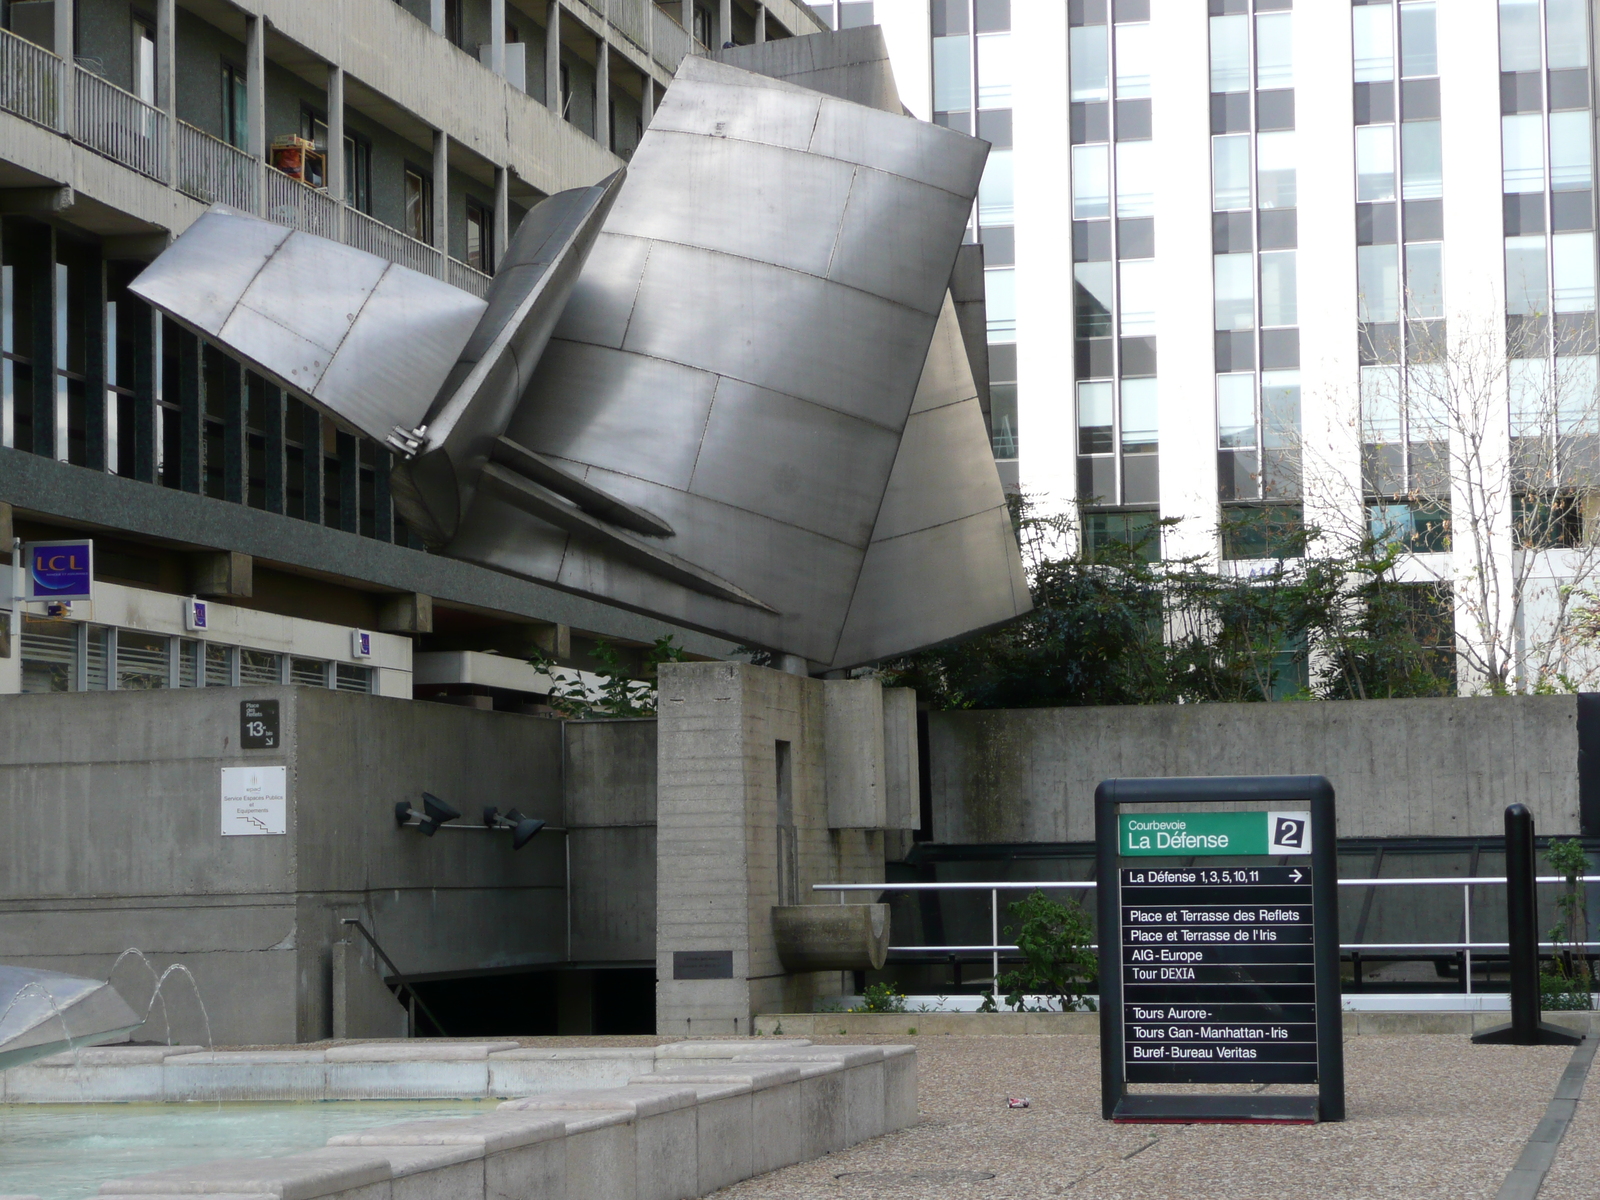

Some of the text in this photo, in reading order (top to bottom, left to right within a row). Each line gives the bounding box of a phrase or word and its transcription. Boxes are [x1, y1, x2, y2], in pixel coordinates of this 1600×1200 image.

[36, 555, 84, 571] LCL
[1128, 820, 1187, 831] Courbevoie
[1280, 821, 1299, 845] 2
[1128, 831, 1230, 850] La Défense
[1129, 871, 1145, 883] La
[1148, 869, 1197, 883] Défense
[1130, 908, 1300, 922] Place et Terrasse des Reflets
[1130, 929, 1277, 942] Place et Terrasse de l'Iris
[1132, 949, 1203, 963] AIG-Europe
[1132, 967, 1196, 980] Tour DEXIA
[1132, 1007, 1165, 1019] Tours
[1133, 1026, 1165, 1039] Tours
[1215, 1046, 1258, 1059] Veritas
